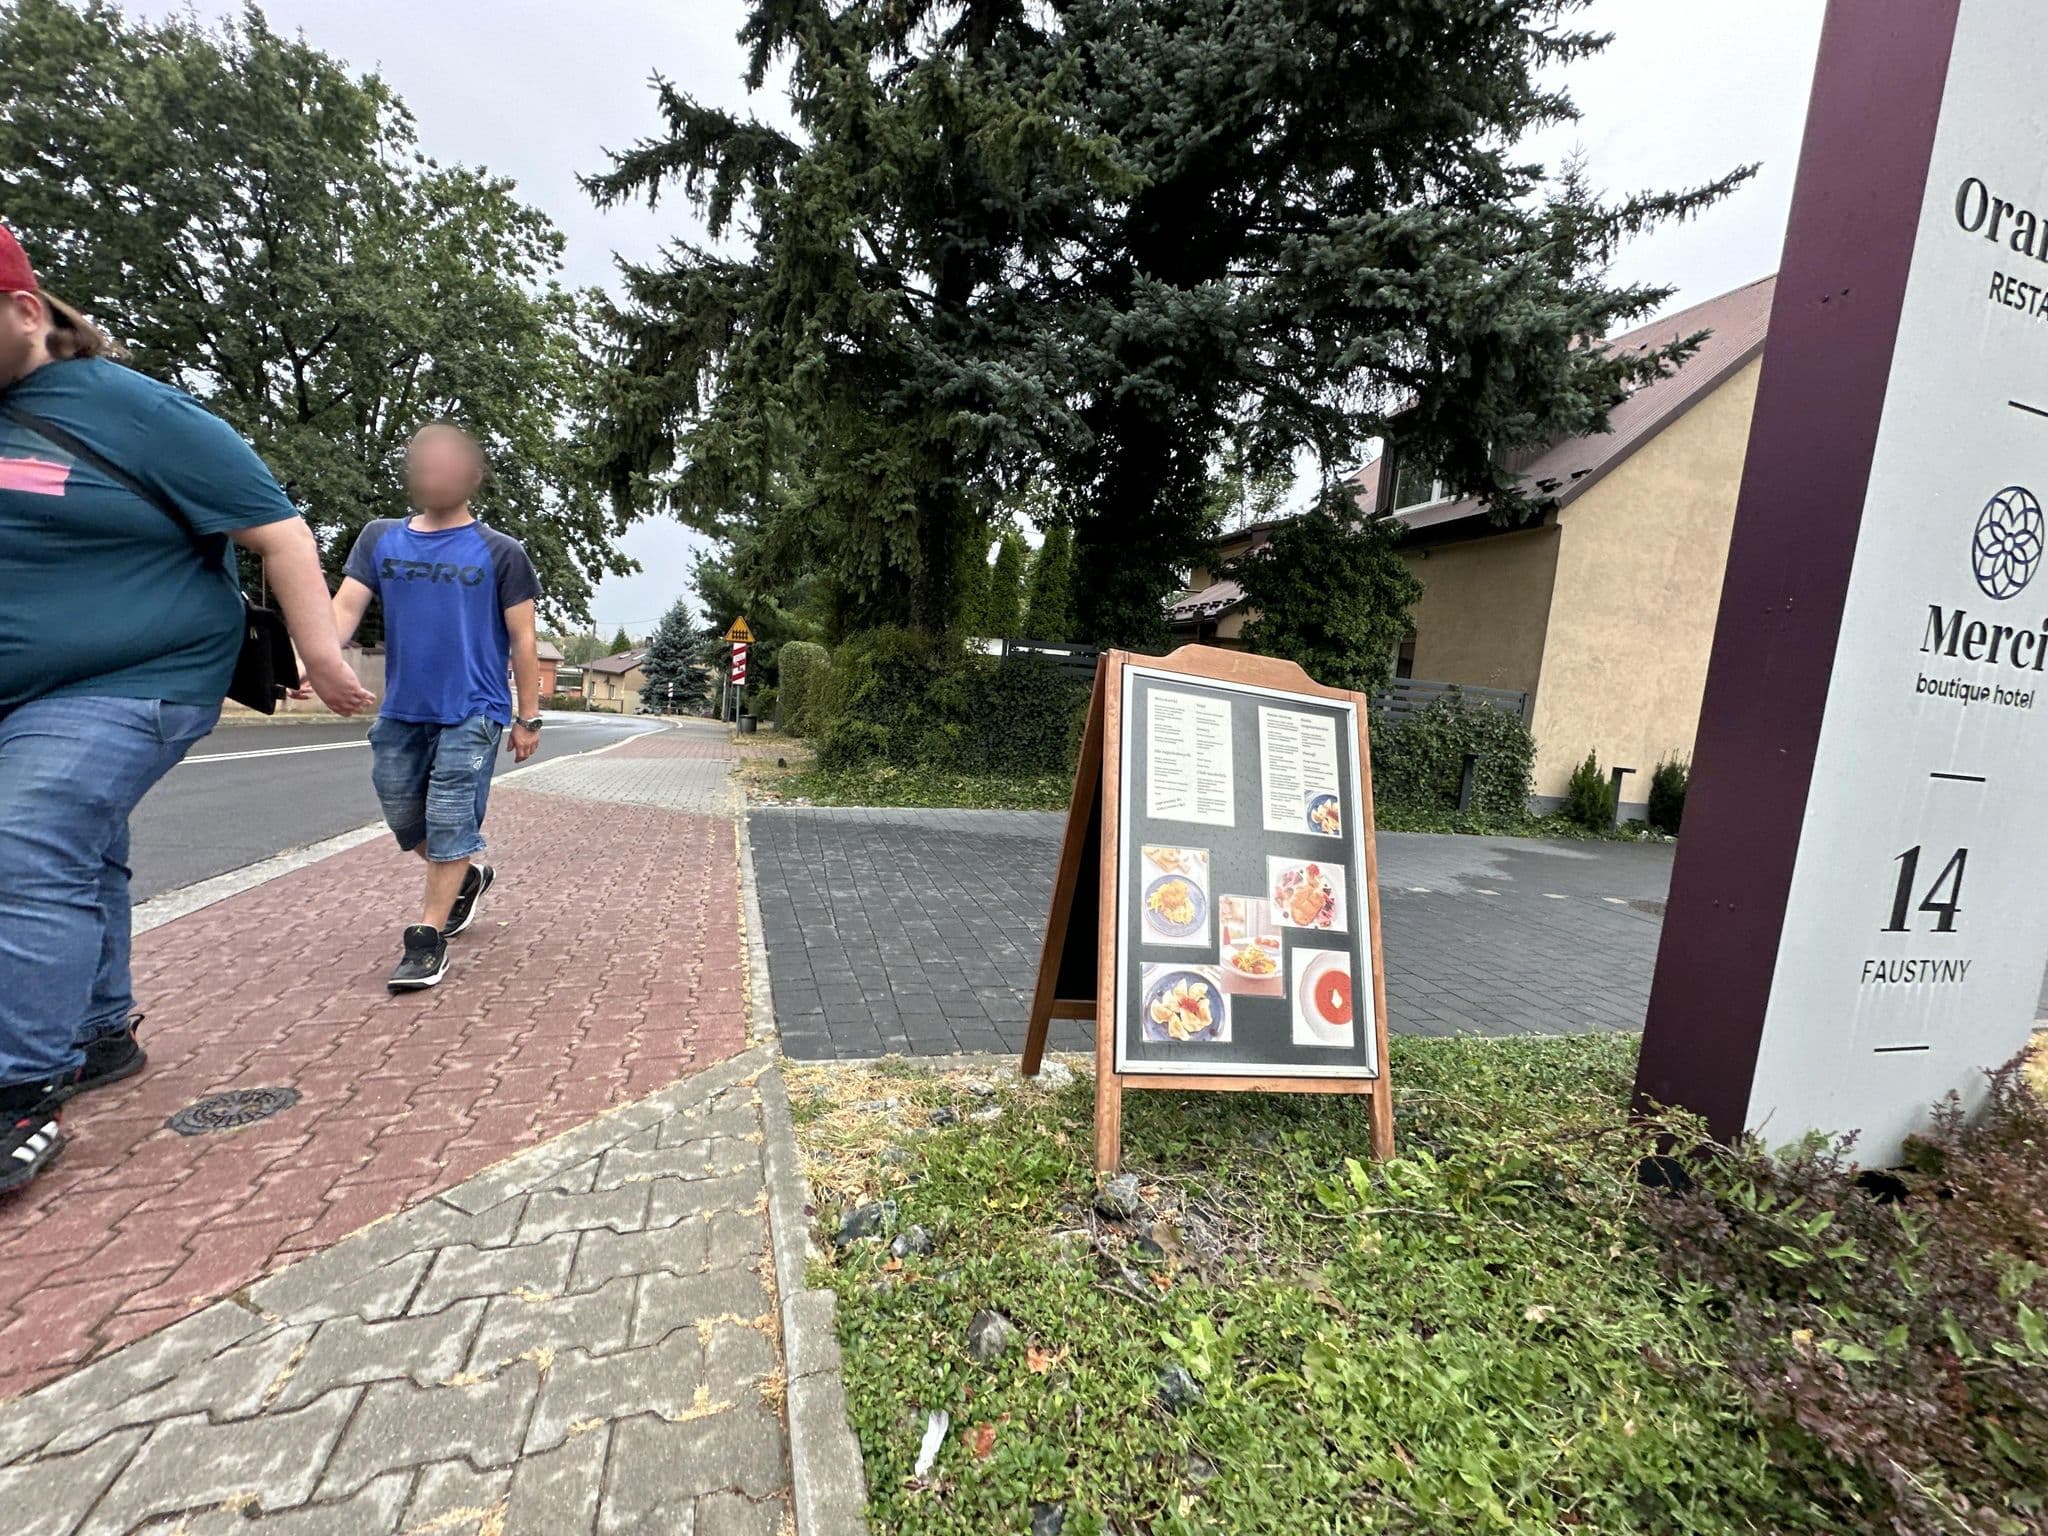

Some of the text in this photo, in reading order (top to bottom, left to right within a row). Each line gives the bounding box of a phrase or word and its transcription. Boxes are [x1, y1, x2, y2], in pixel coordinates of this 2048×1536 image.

[1920, 604, 2048, 671] Merci
[1916, 672, 2036, 709] boutique hotel
[1880, 845, 1968, 932] 14
[1861, 960, 1972, 984] FAUSTYNY
